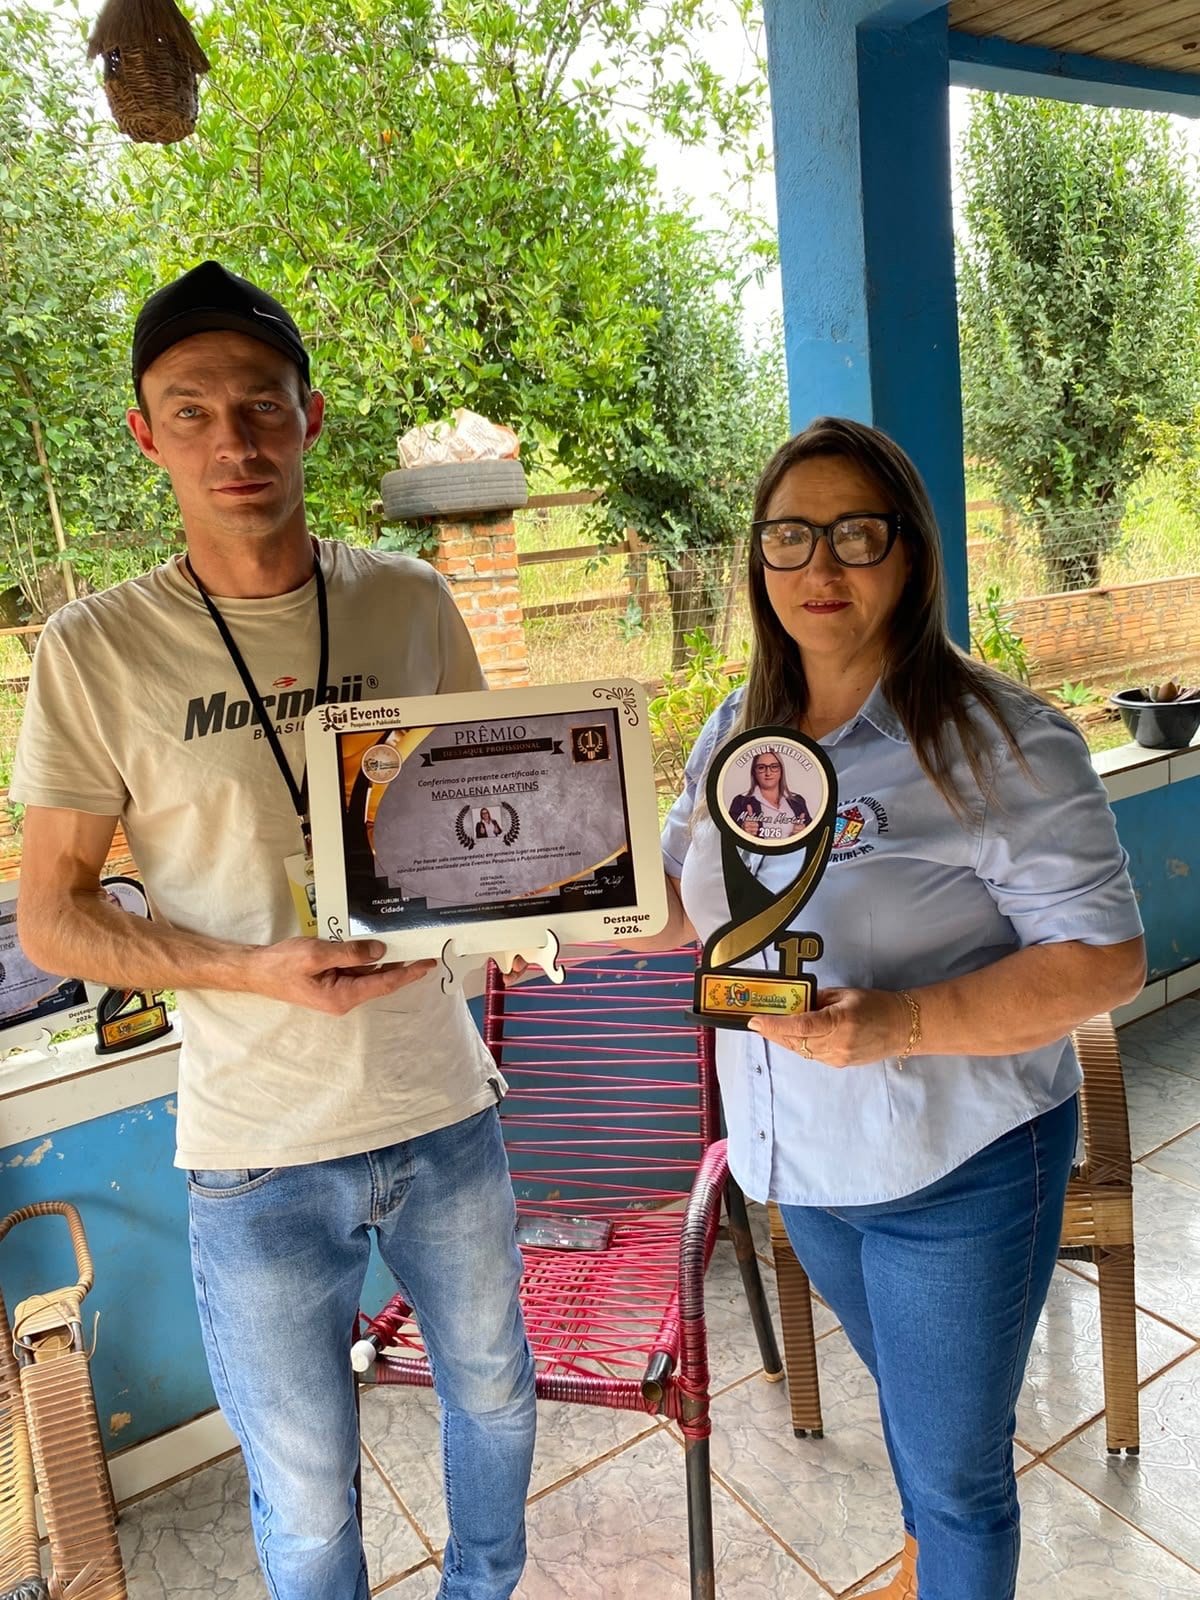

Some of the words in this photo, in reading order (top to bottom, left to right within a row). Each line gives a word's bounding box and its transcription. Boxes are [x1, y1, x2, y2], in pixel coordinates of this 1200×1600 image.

[350, 706, 400, 721] Eventos
[454, 725, 527, 746] PRÊMIO
[486, 742, 541, 753] PROFISSIONAL
[736, 744, 771, 768] DESTAQUE
[773, 744, 813, 772] VEREADORA
[418, 777, 460, 788] Conferimos
[466, 773, 499, 784] presente
[500, 769, 540, 779] certificado
[432, 786, 490, 800] MADALENA
[492, 781, 539, 794] MARTINS
[857, 796, 889, 835] MUNICIPAL
[759, 827, 781, 838] 2026
[584, 888, 603, 896] Diretor
[380, 906, 404, 914] Cidade
[603, 914, 650, 924] Destaque
[613, 925, 642, 935] 2026.
[68, 1006, 97, 1019] Destaqu
